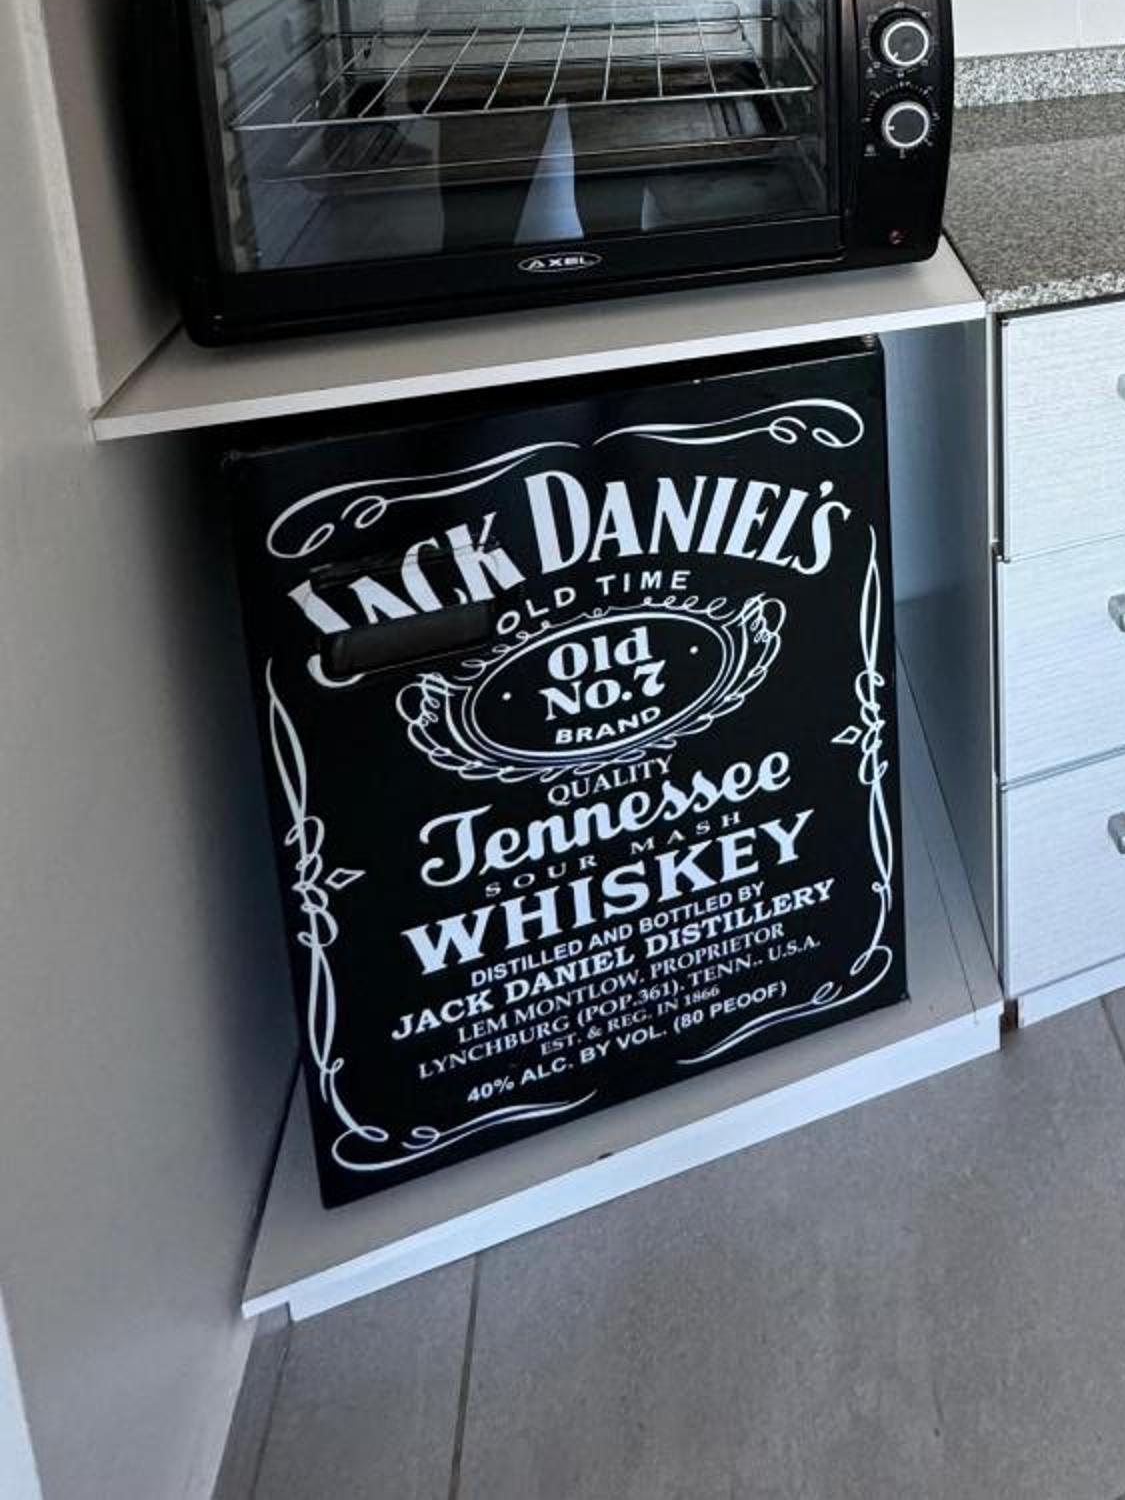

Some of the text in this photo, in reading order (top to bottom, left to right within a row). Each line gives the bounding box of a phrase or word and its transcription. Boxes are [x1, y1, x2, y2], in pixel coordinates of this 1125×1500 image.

[528, 255, 594, 270] AXEL
[524, 470, 851, 575] DANIEL'S
[496, 569, 691, 635] OLD TIME
[547, 625, 653, 681] Old
[555, 706, 662, 745] BRAND
[418, 751, 792, 888] Tennessee
[547, 754, 674, 806] QUALITY
[401, 808, 815, 976] WHISKEY
[484, 811, 741, 897] SOUR MASH
[391, 878, 835, 1041] JACK DANIEL DISTILLERY
[470, 881, 765, 988] DISTILLED AND BOTTLED BY
[418, 1015, 570, 1080] LYNCHBURG
[768, 935, 821, 962] U.S.A.
[458, 1013, 508, 1044] LEM
[650, 922, 785, 979] PROPRIETOR
[587, 1025, 603, 1040] &
[657, 1002, 679, 1016] IN
[684, 984, 720, 1007] 1866
[467, 1075, 515, 1103] 40%
[520, 1056, 574, 1085] ALC.
[580, 1039, 611, 1064] BY
[616, 1025, 667, 1050] VOL.
[673, 1009, 704, 1035] (80
